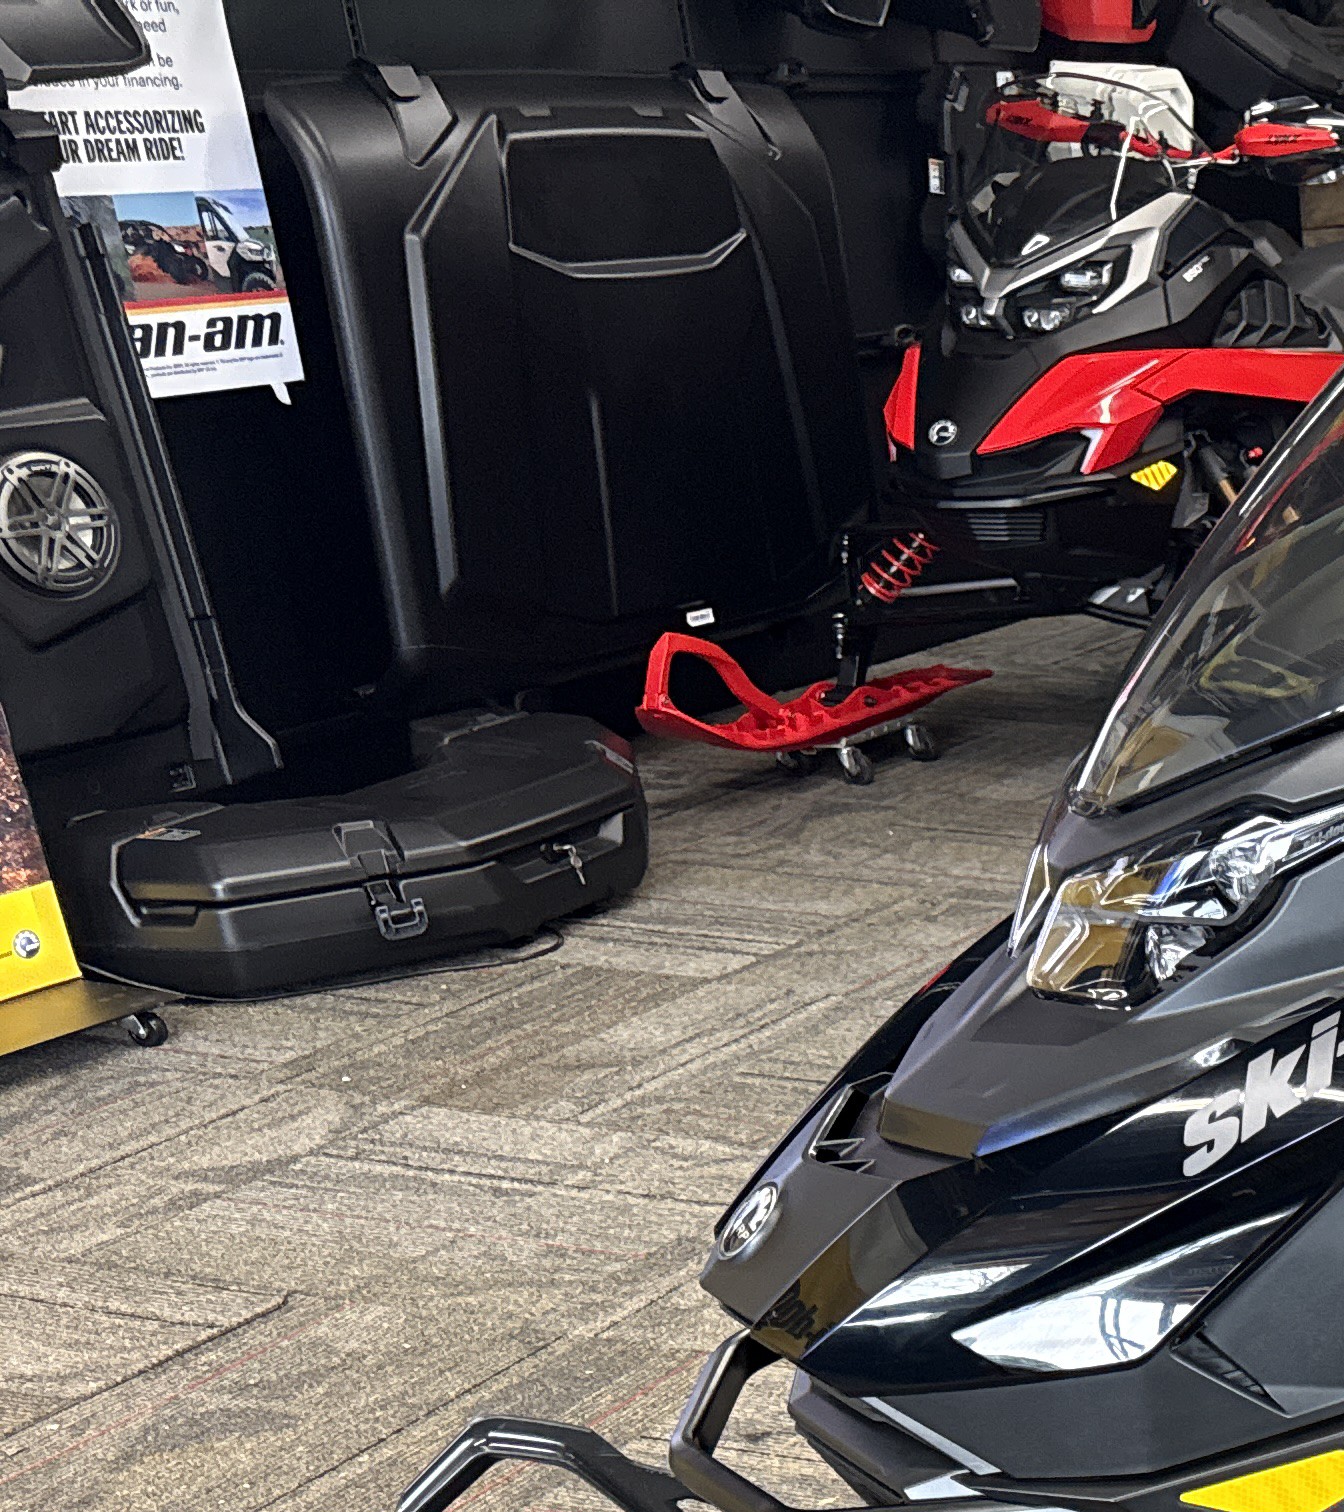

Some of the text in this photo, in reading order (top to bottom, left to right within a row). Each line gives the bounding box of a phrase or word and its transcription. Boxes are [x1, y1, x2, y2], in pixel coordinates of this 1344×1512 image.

[136, 19, 166, 33] eed
[157, 53, 174, 67] be
[47, 109, 206, 136] ART ACCESSORIZING
[61, 136, 186, 164] UR DREAM RIDE!
[129, 311, 282, 360] an-am
